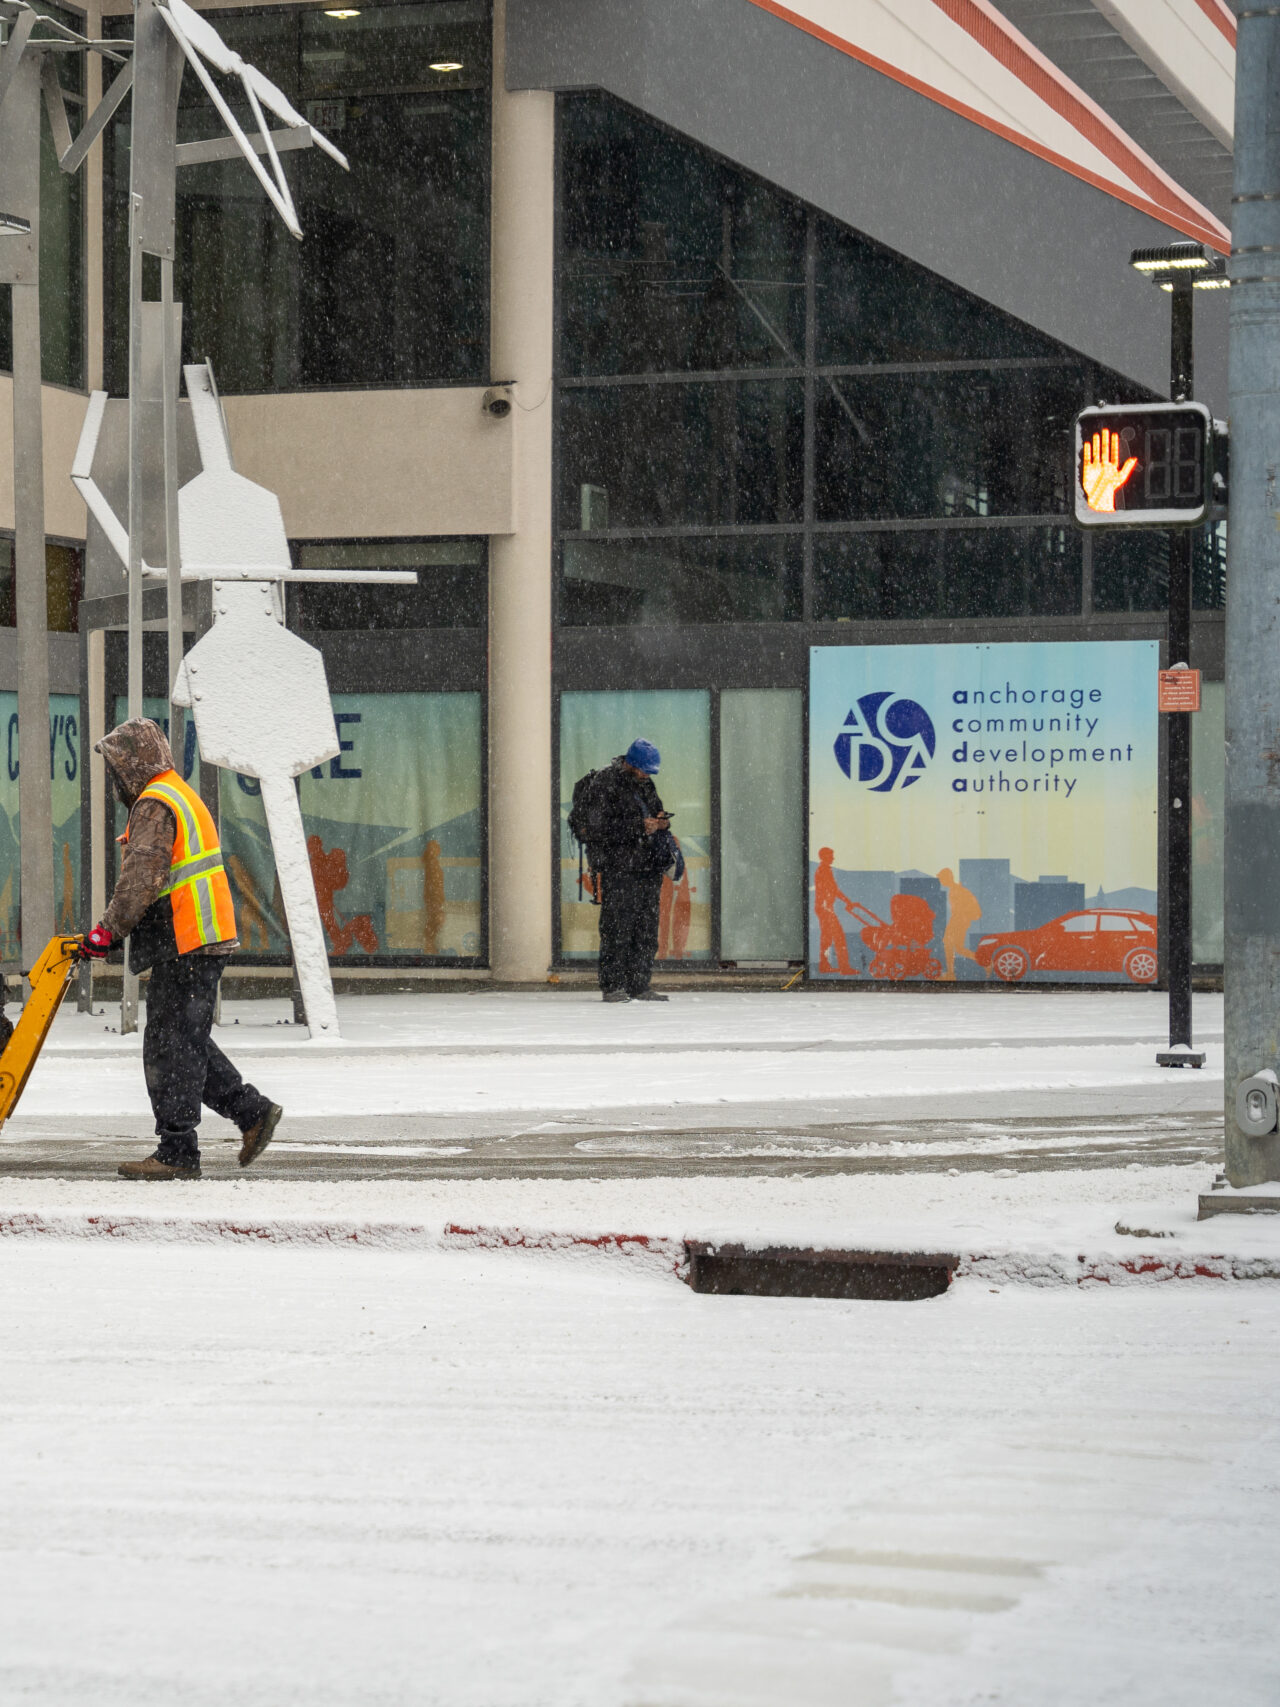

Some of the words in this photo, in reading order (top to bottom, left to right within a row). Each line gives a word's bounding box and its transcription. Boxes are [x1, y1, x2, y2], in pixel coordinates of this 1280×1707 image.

[952, 682, 1102, 708] anchorage
[952, 713, 1099, 737] community
[8, 711, 78, 781] CY'S
[952, 741, 1133, 767] development
[952, 770, 1077, 797] authority
